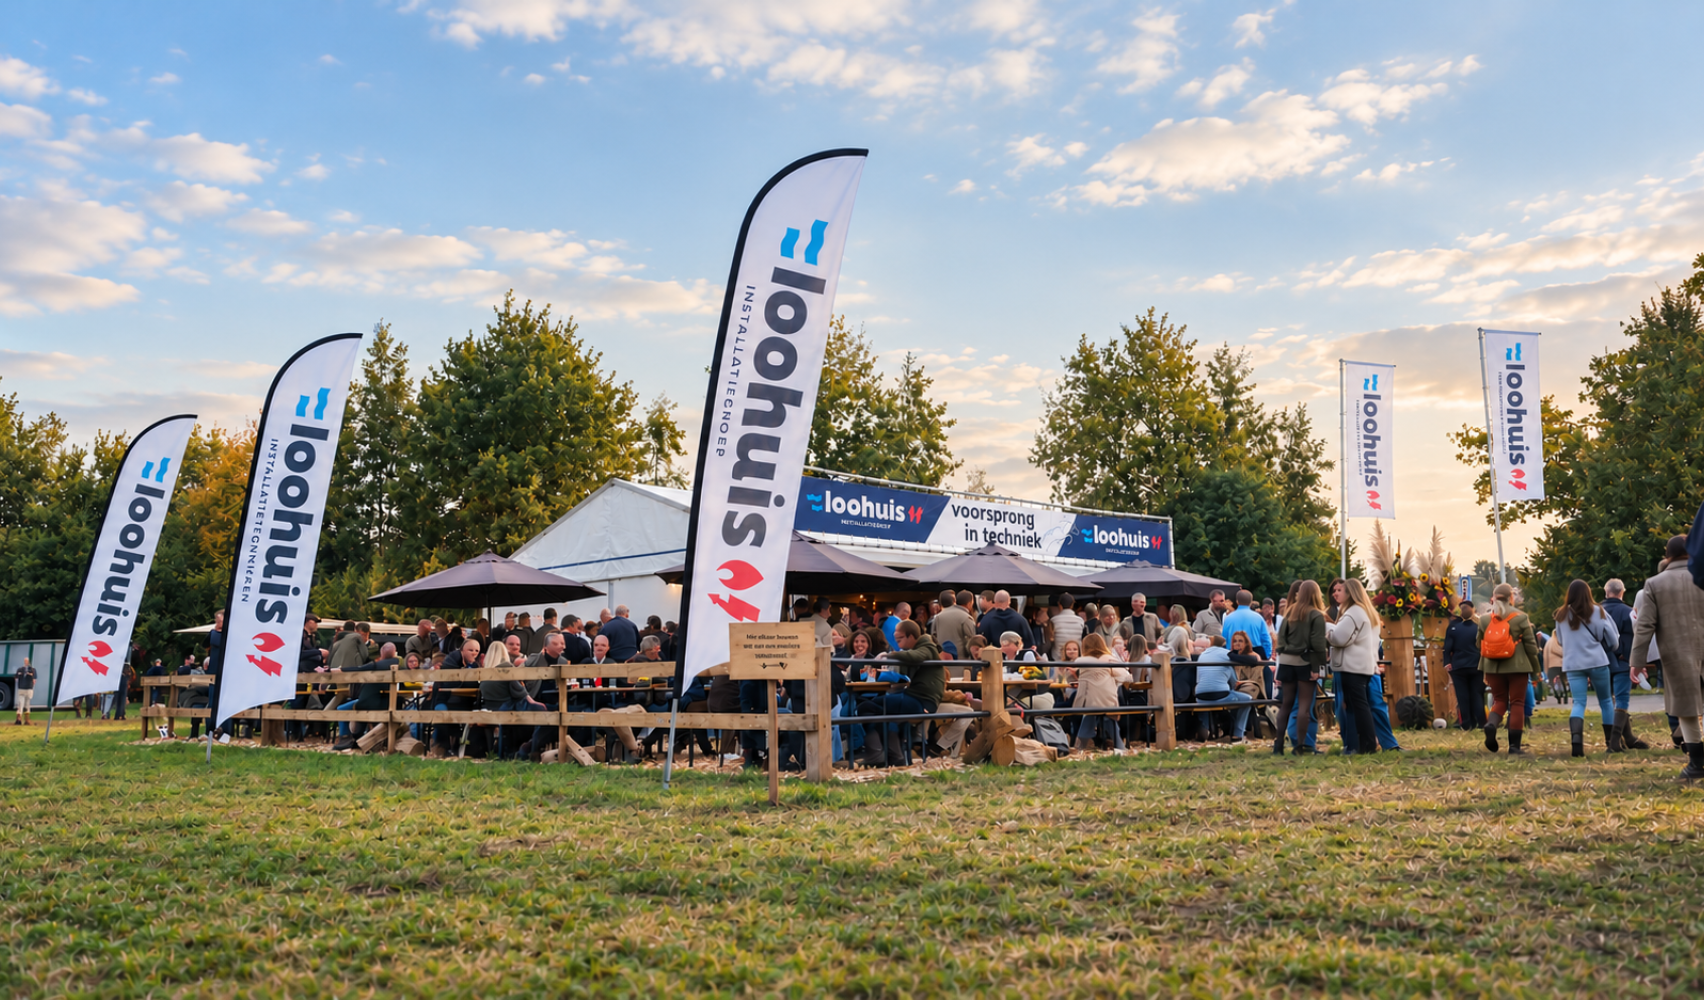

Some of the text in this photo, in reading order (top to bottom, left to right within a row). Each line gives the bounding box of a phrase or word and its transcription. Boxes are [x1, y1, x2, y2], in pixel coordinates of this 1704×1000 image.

[721, 266, 826, 548] loohuis
[1363, 394, 1382, 487] loohuis
[1506, 364, 1530, 465] loohuis
[255, 423, 330, 624] loohuis
[825, 490, 905, 522] loohuis
[951, 504, 1034, 530] voorsprong
[965, 524, 1042, 549] in techniek
[1094, 525, 1150, 549] loohuis
[92, 483, 165, 636] loohuis
